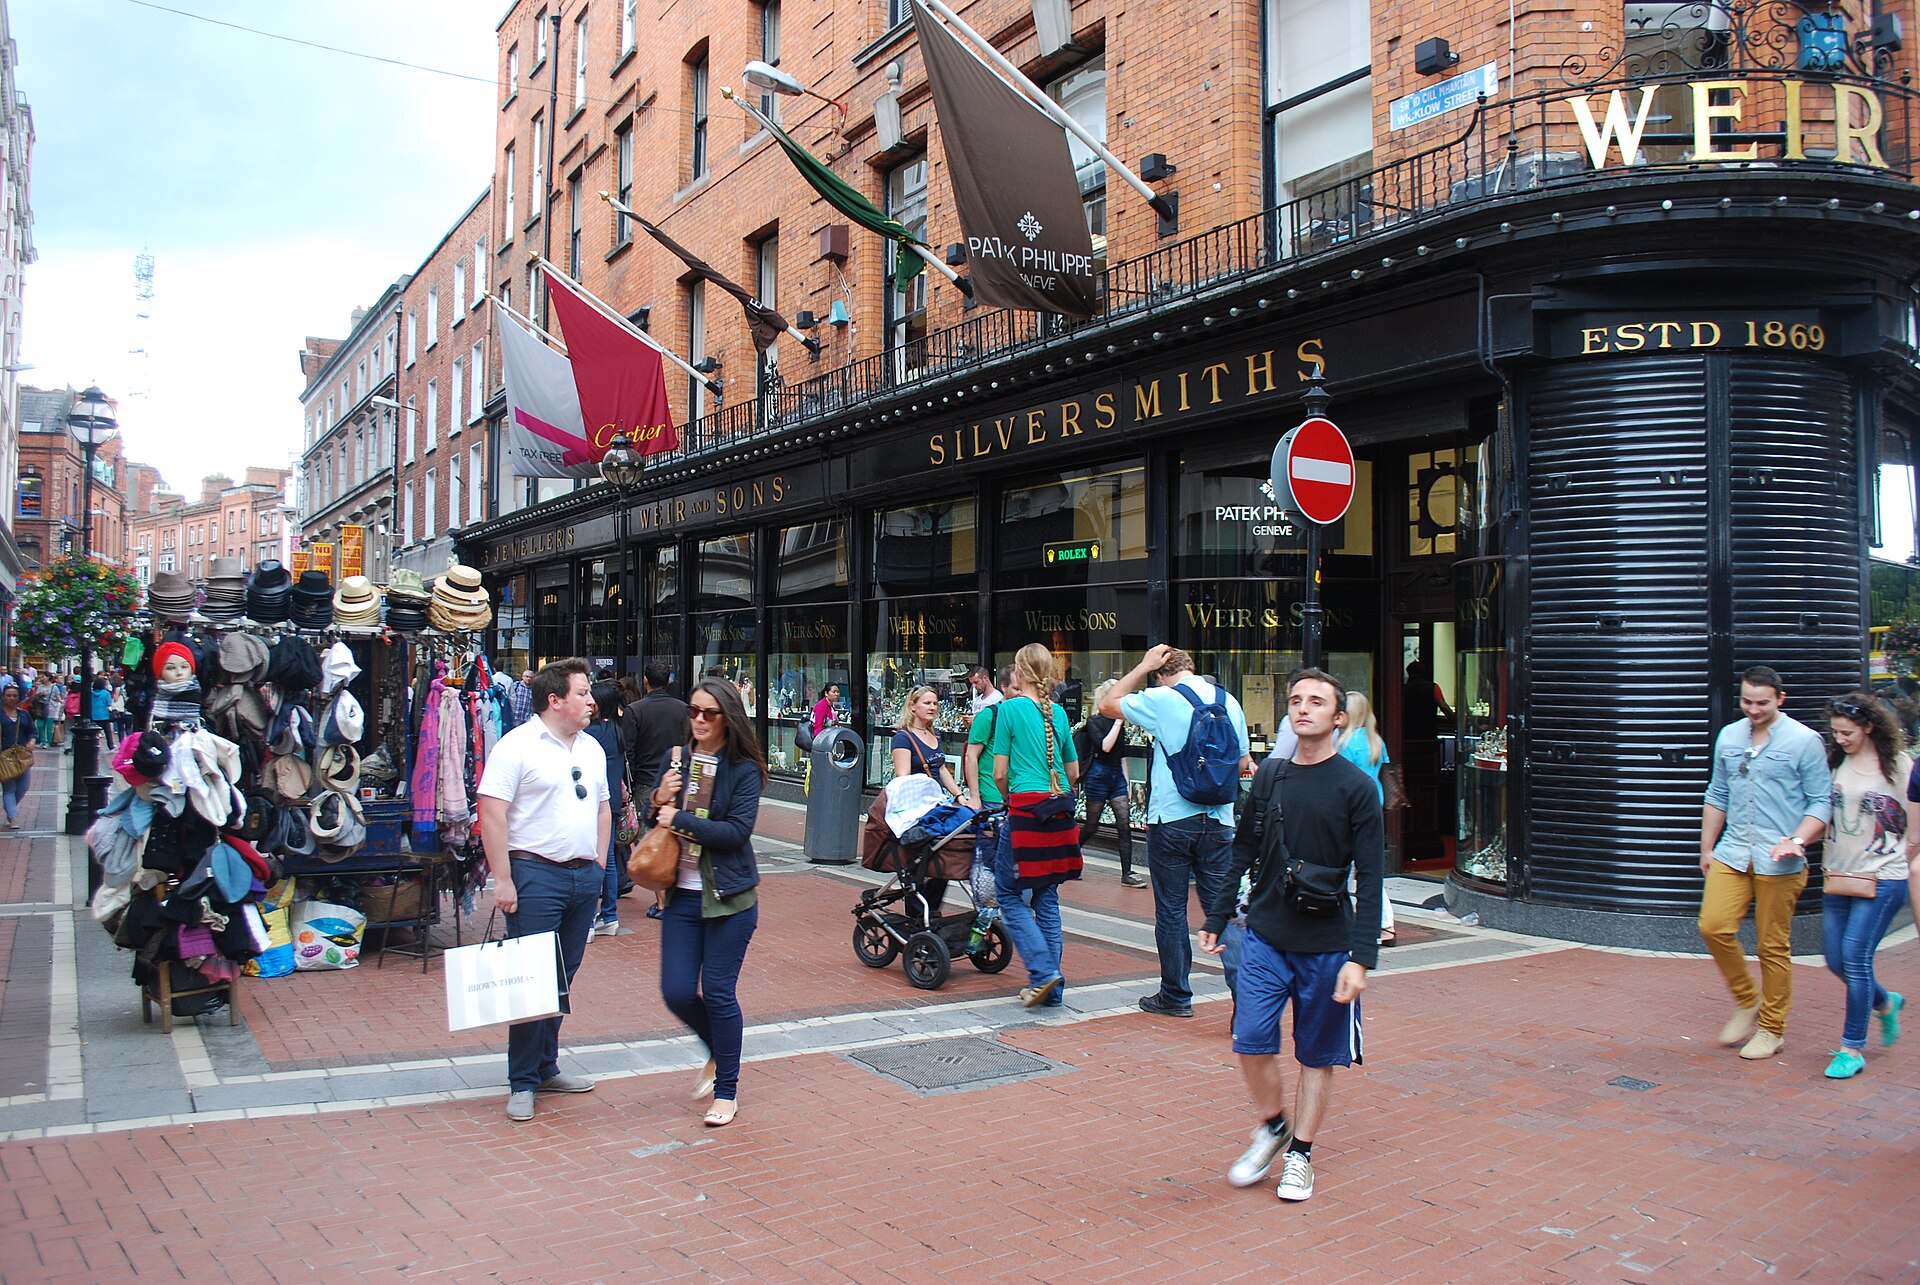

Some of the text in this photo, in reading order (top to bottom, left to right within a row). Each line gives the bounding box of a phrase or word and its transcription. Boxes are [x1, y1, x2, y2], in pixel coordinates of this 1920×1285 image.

[1489, 70, 1497, 87] 2
[1400, 95, 1421, 112] SRID
[1444, 86, 1479, 109] STREET
[1565, 80, 1889, 170] WEIR
[968, 236, 1093, 277] PATK PHILIPPE
[1581, 321, 1825, 355] ESTD 1869
[929, 338, 1327, 465] SILVERSMITHS
[518, 447, 539, 460] TAX
[639, 499, 686, 530] WEIR
[690, 500, 711, 515] AND
[1215, 506, 1261, 520] PATEK
[1252, 525, 1293, 536] GENEVE
[315, 546, 331, 554] NO
[495, 527, 575, 563] JEWELLERS
[1057, 547, 1088, 561] ROLEX
[889, 614, 956, 636] WEIR & SONS
[1024, 607, 1117, 632] WEIR & SONS
[1184, 601, 1353, 629] WEIR & SNS
[783, 620, 836, 640] WEIR & SONS
[467, 981, 498, 993] BROWN
